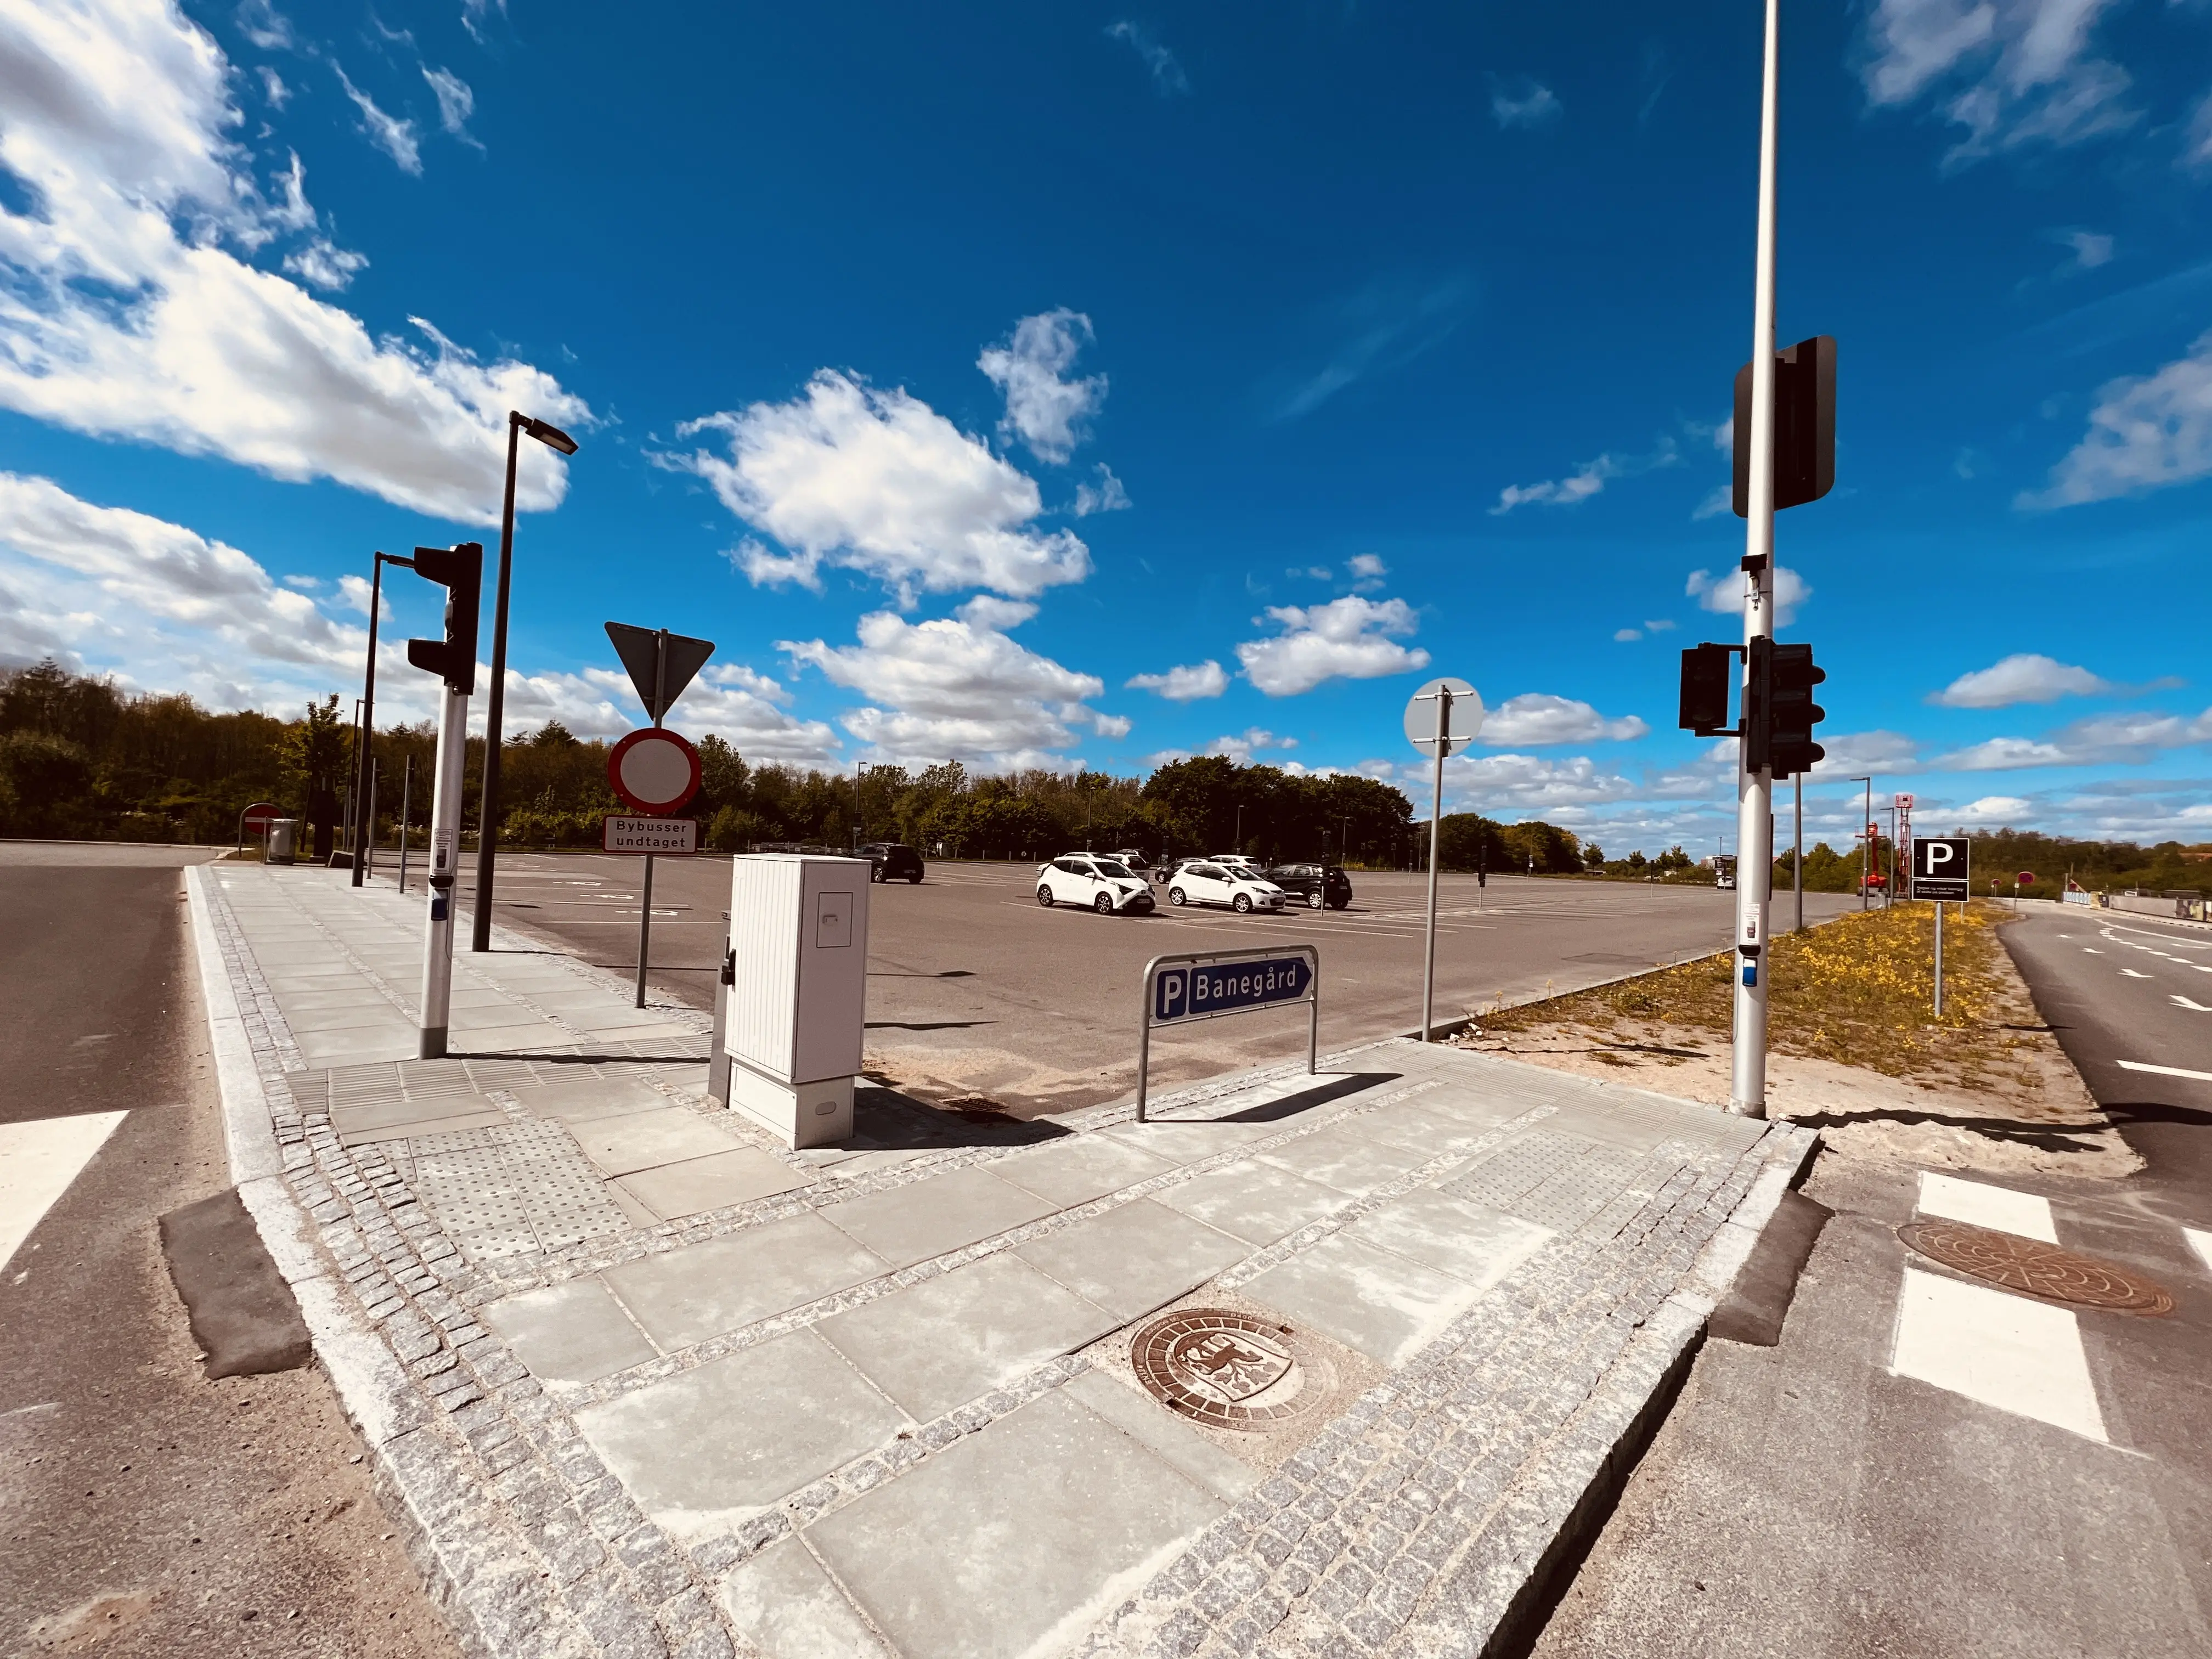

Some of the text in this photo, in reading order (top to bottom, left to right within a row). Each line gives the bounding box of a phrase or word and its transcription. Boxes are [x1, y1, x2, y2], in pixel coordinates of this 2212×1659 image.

[617, 820, 686, 833] Bybusser
[617, 837, 685, 849] undtaget
[1927, 843, 1953, 874] P
[1164, 964, 1296, 1014] P Banegård
